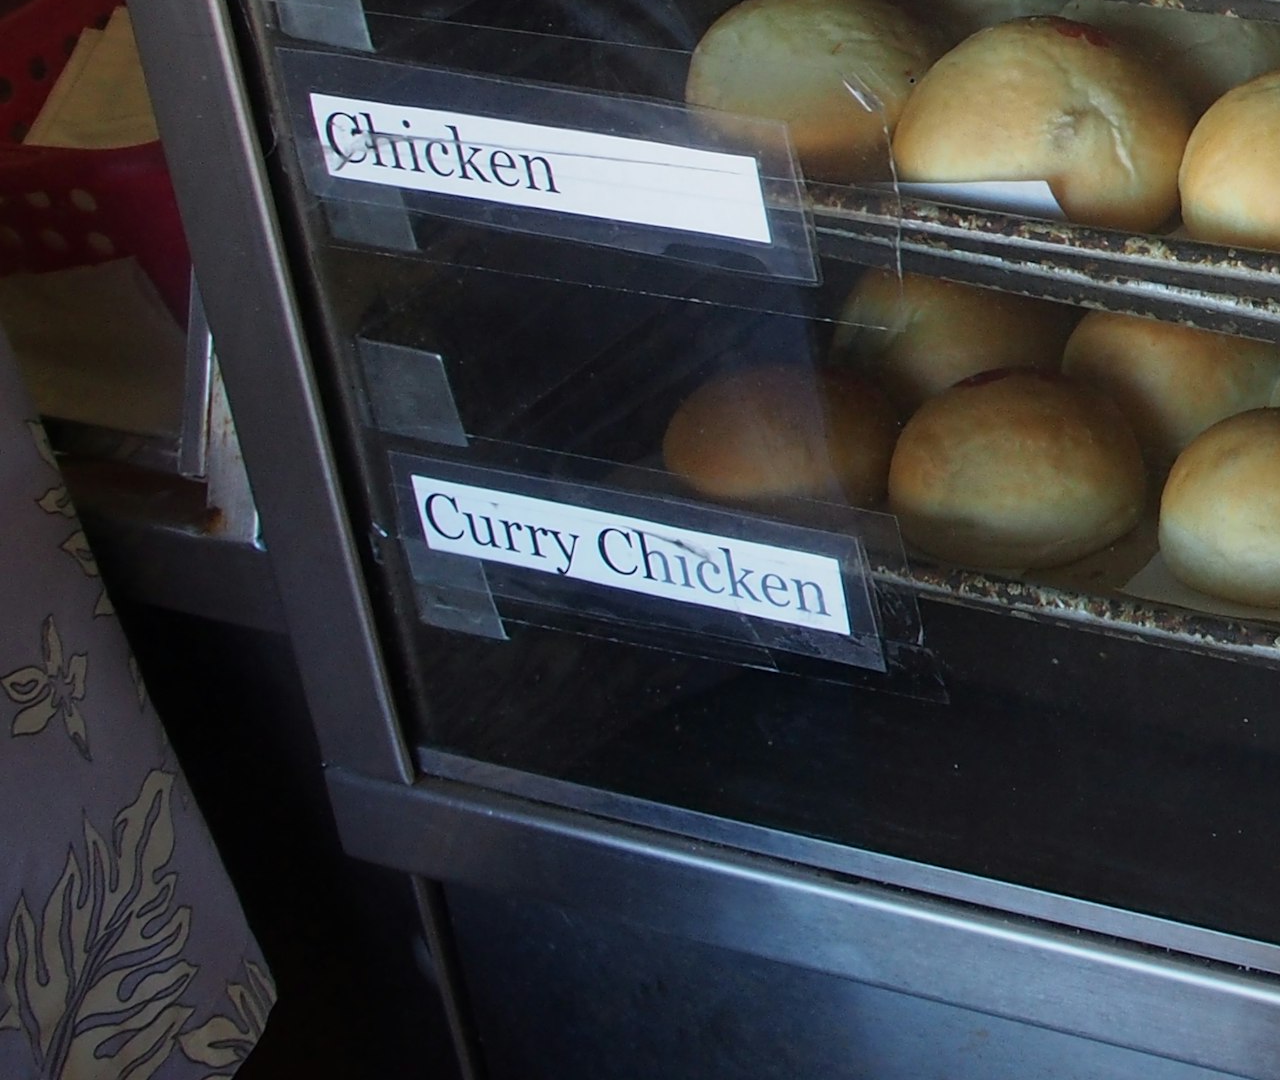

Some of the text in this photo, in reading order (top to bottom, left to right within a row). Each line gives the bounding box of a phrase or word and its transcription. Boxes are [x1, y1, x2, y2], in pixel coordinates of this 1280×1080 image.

[325, 111, 561, 194] Chicken
[424, 492, 832, 617] Curry Chicken
